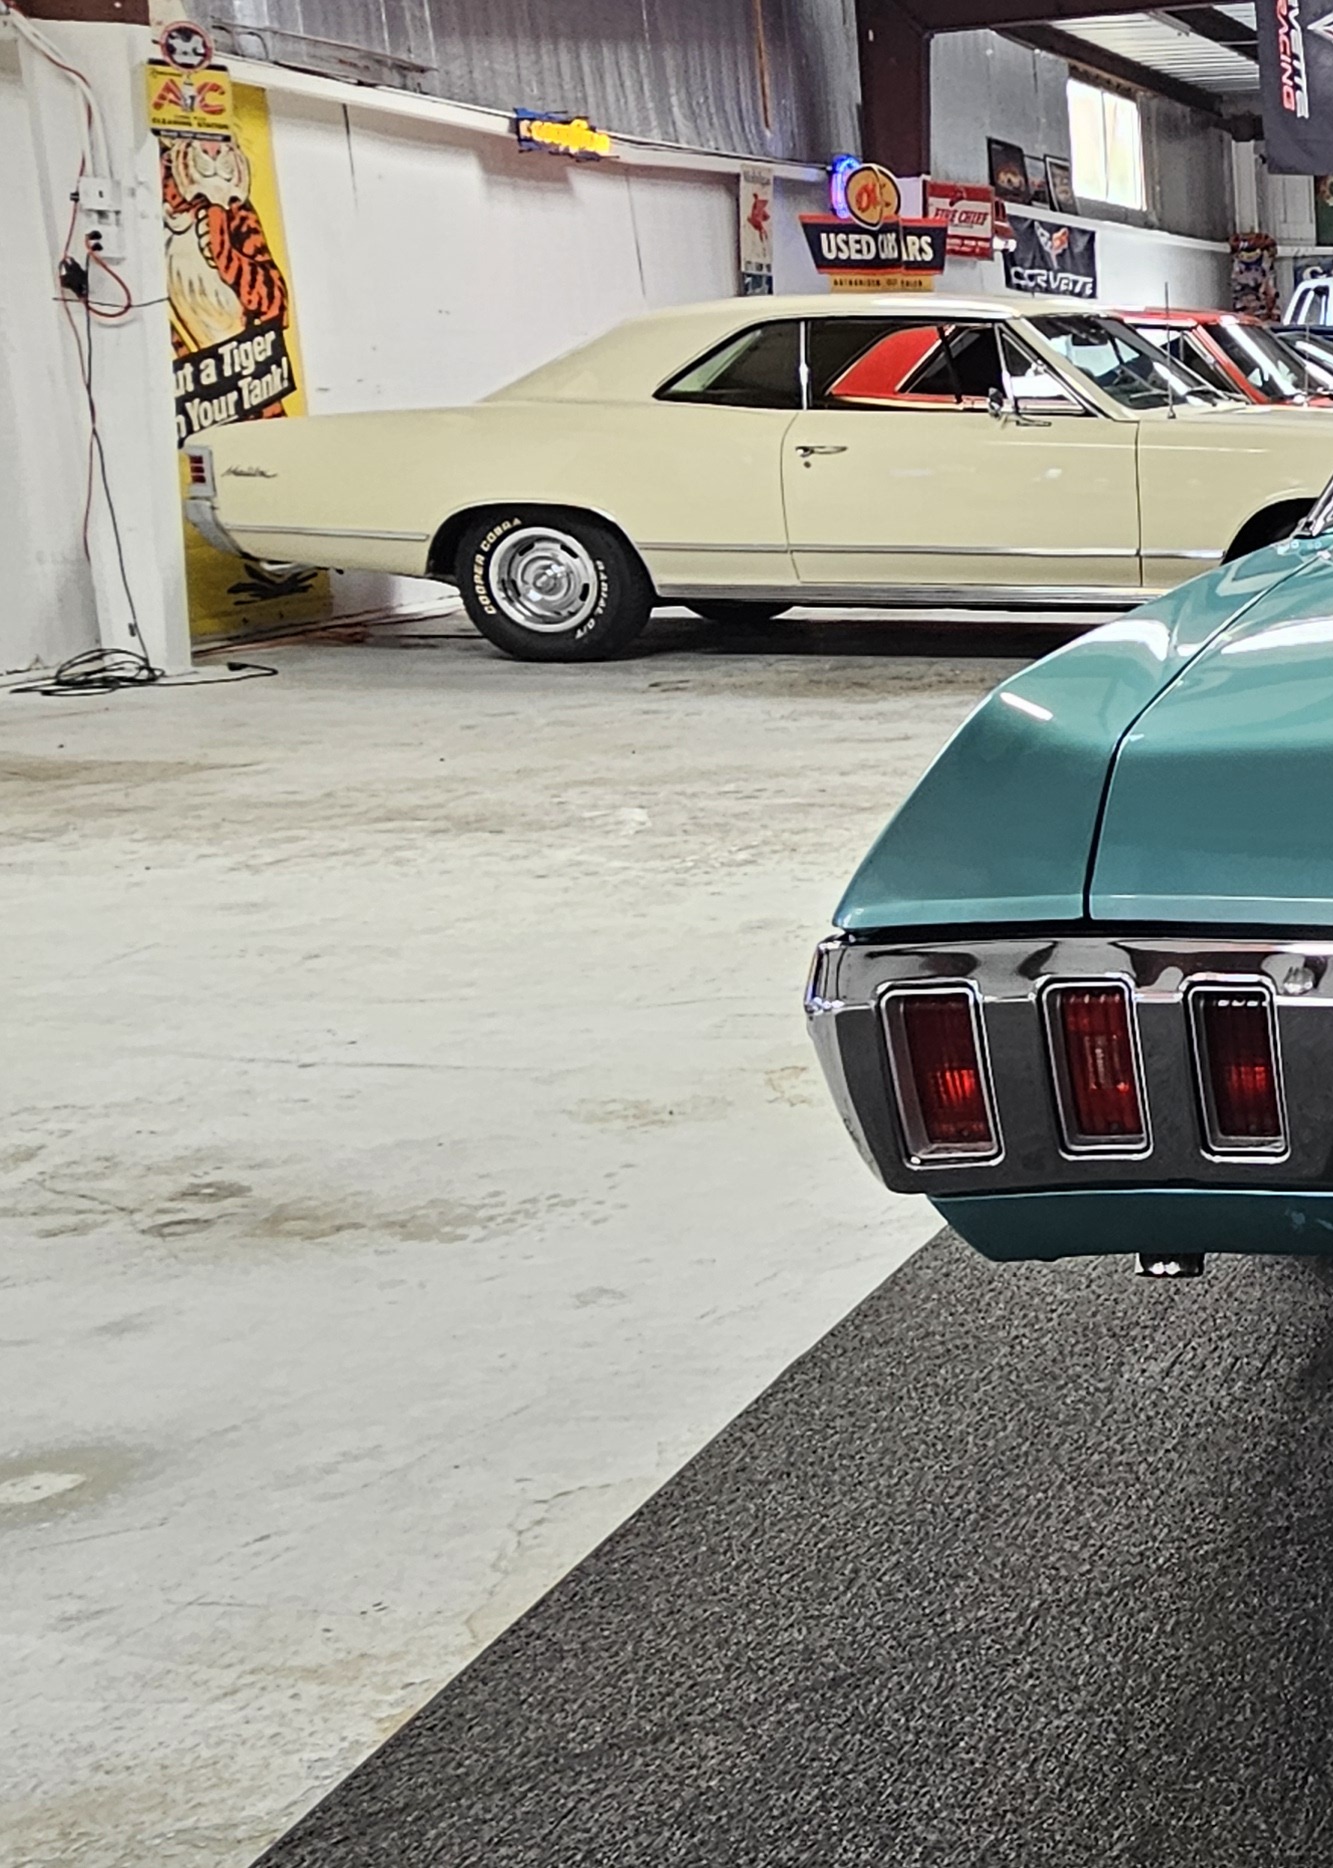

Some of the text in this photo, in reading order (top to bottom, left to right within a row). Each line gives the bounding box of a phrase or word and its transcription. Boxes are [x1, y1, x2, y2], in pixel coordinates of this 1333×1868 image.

[958, 210, 989, 226] CHIEF
[820, 232, 876, 260] USED
[200, 358, 218, 386] a
[218, 331, 276, 377] Tiger
[184, 390, 239, 432] Your
[237, 356, 289, 410] Tank!
[473, 517, 522, 615] COOPER COBRA
